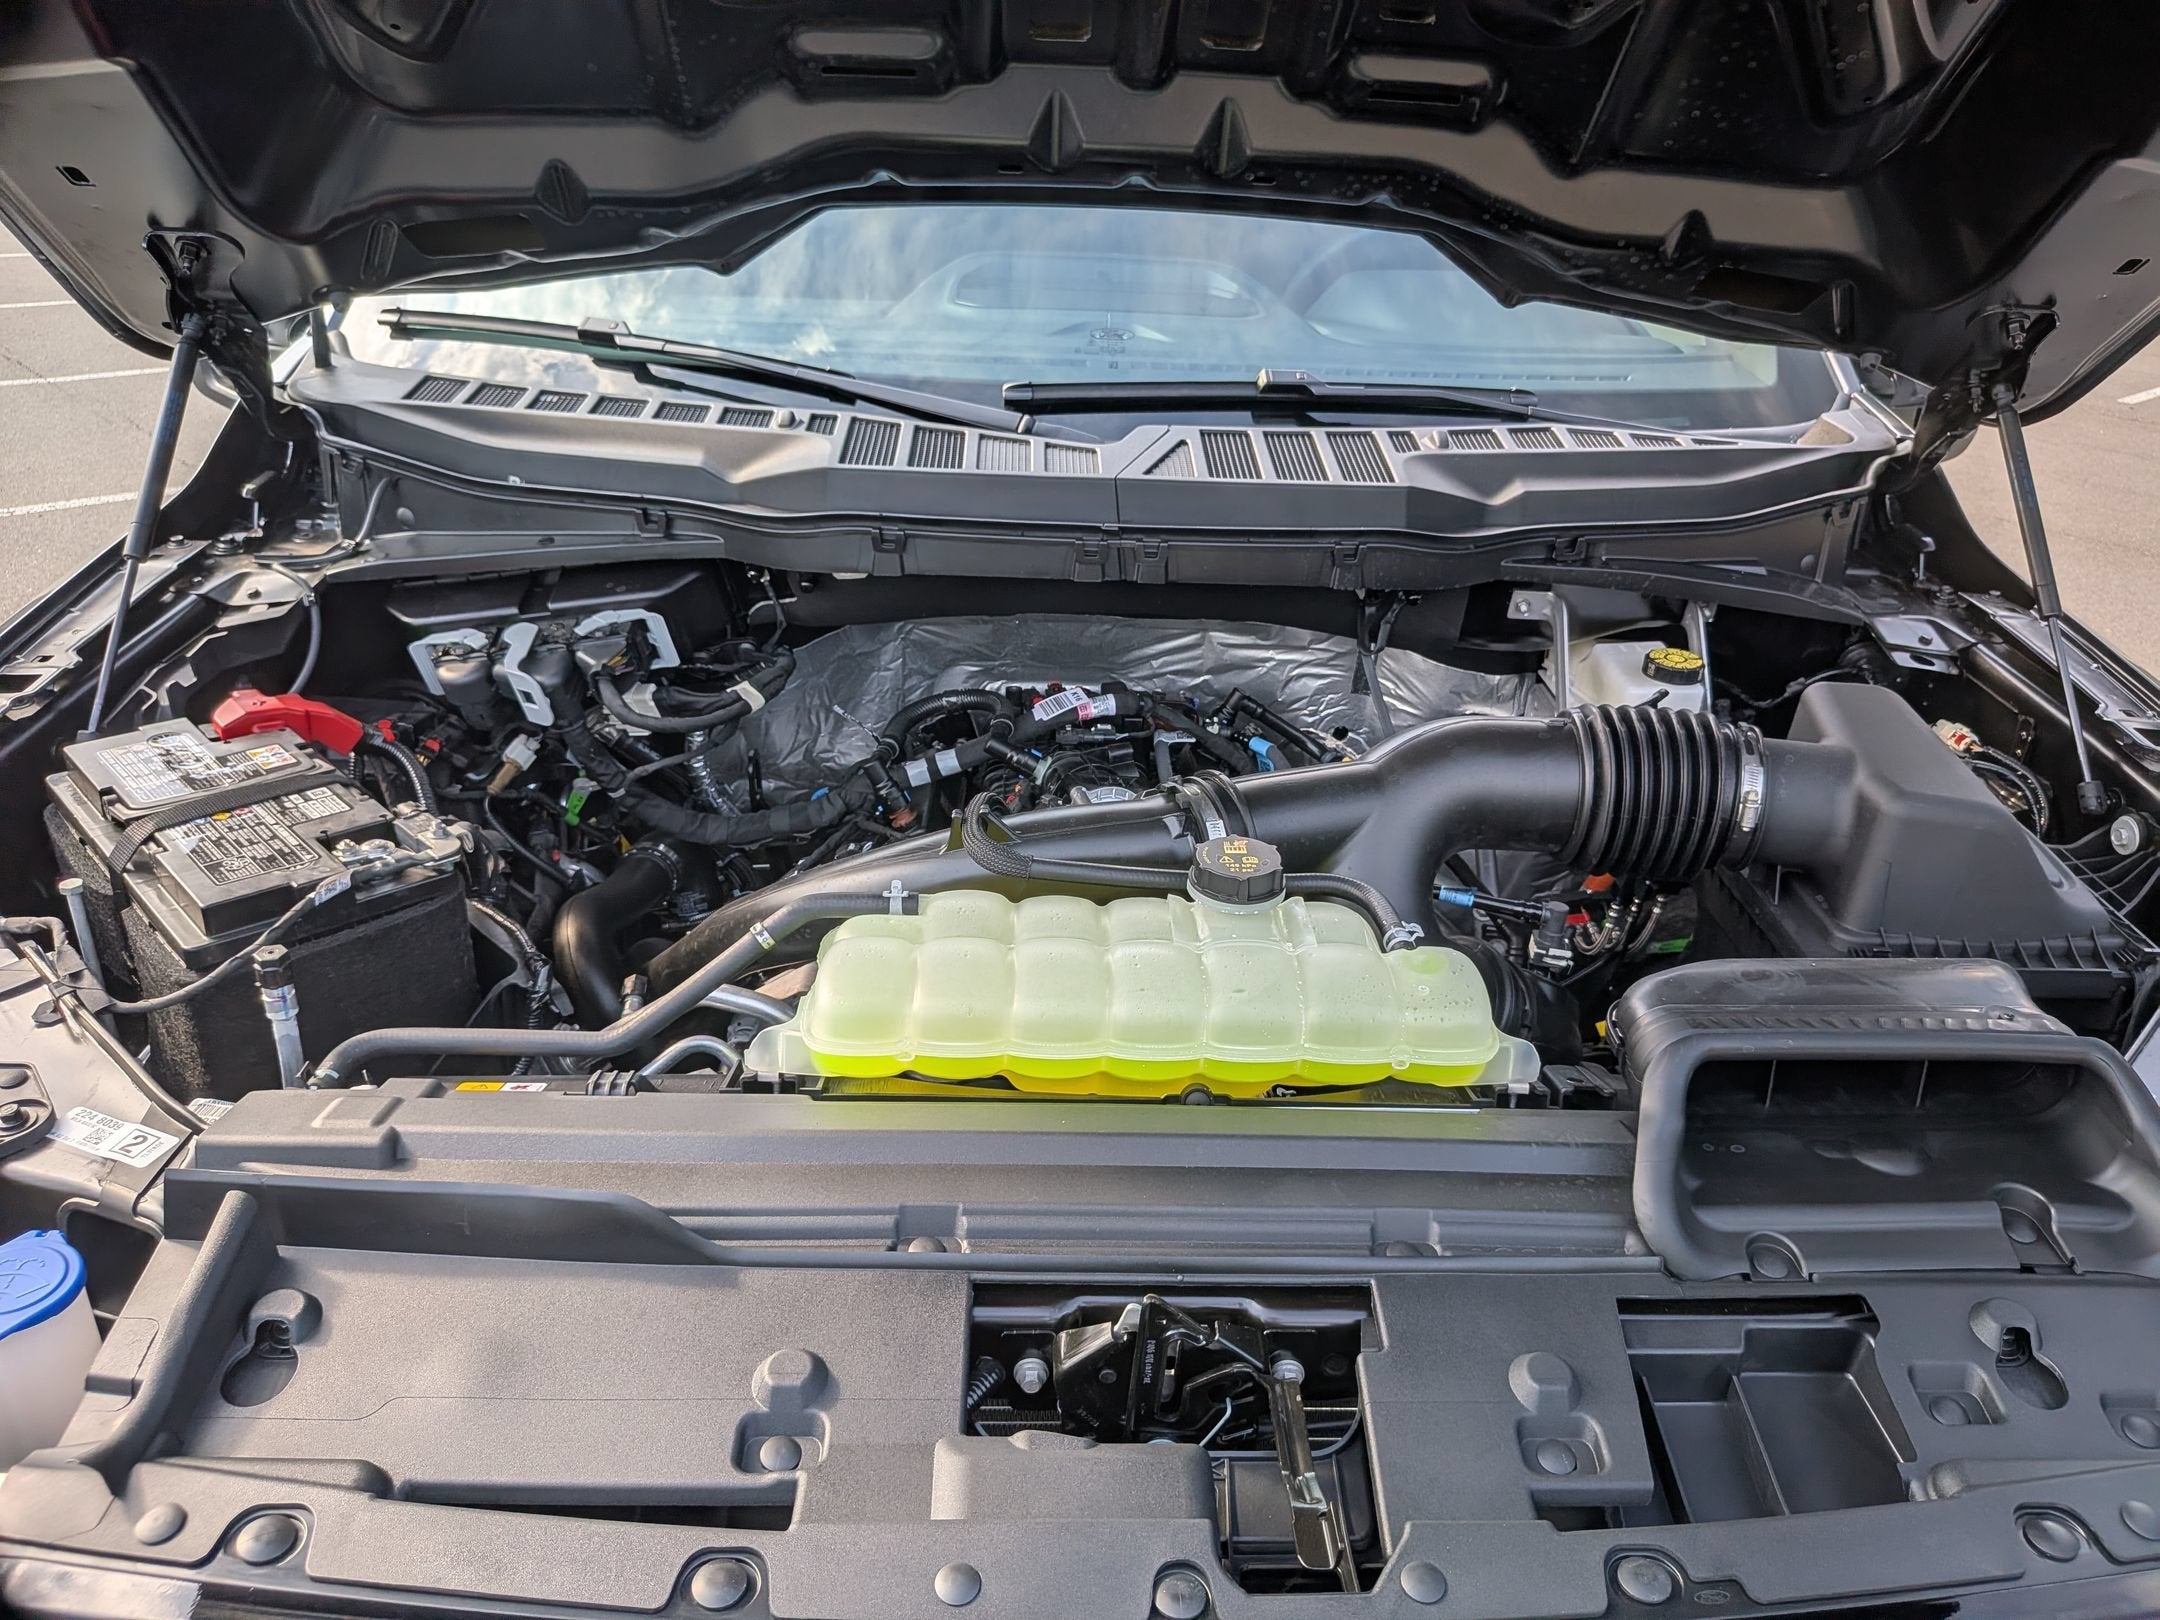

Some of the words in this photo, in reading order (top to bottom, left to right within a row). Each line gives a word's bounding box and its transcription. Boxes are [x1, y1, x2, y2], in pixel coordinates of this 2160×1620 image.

[75, 1109, 99, 1121] 224
[96, 1116, 125, 1131] 8039
[118, 1134, 149, 1154] 2
